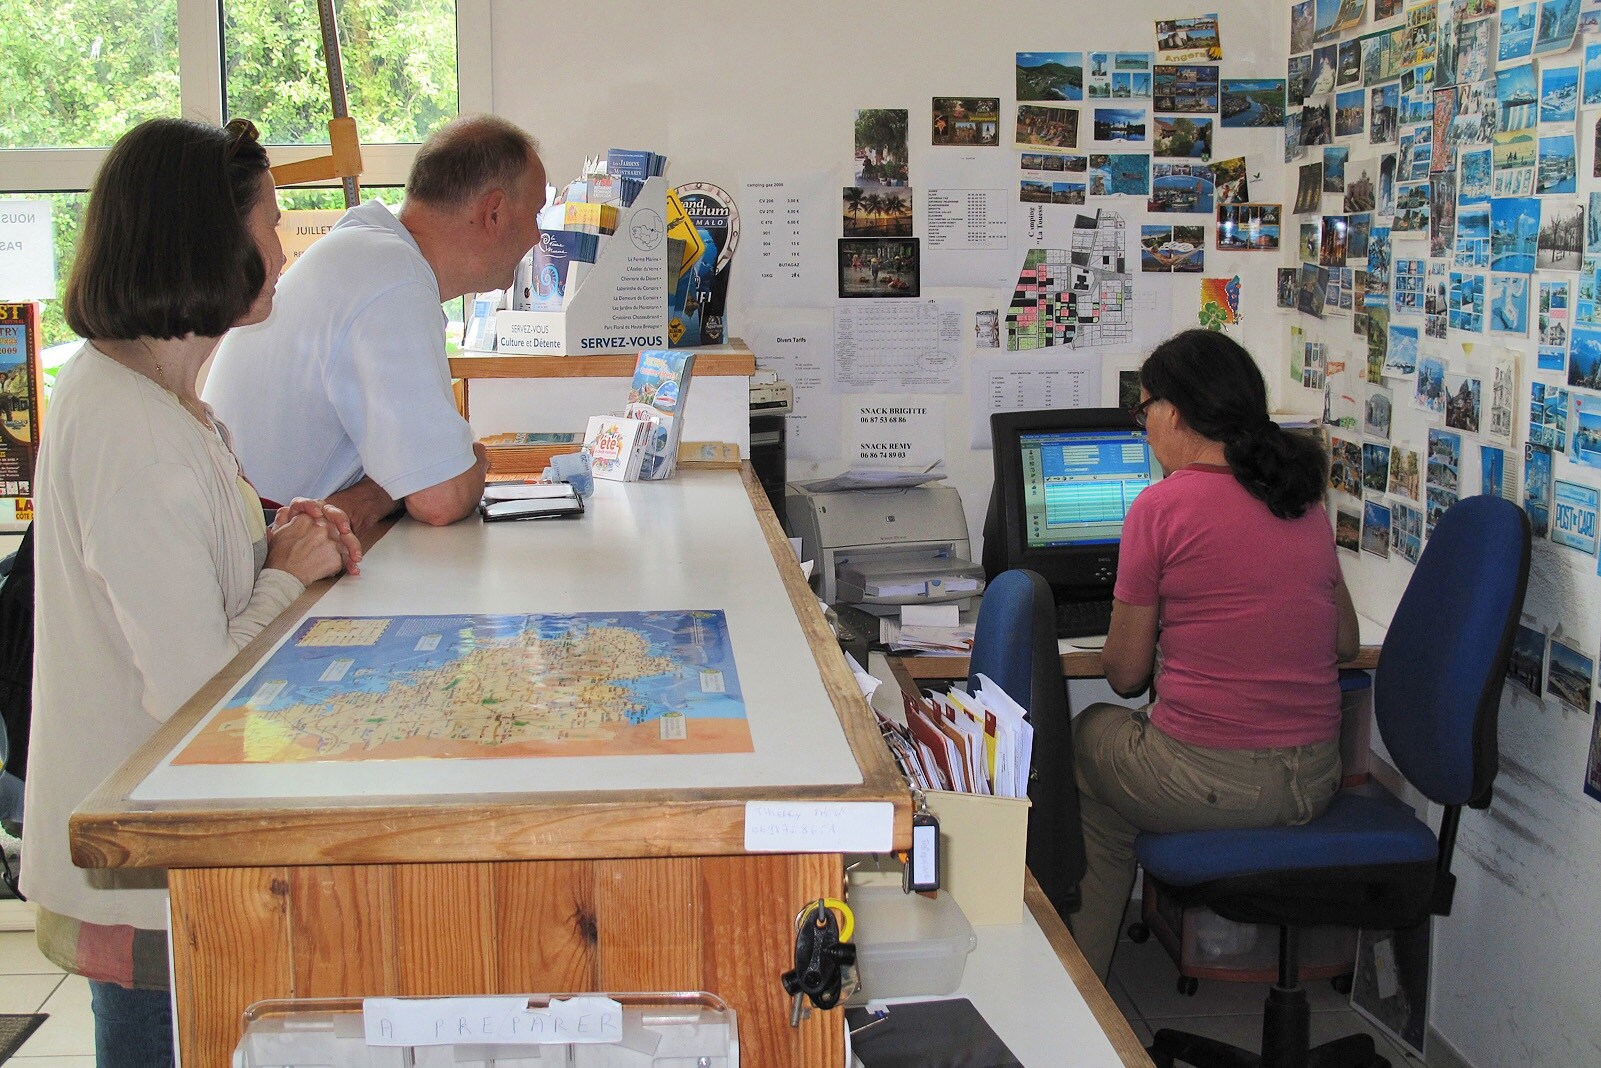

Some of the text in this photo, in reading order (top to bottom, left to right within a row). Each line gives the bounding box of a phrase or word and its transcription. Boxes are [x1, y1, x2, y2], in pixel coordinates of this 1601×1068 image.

[1165, 52, 1206, 62] Angers
[296, 226, 332, 235] JUILLET
[512, 325, 549, 333] SERVEZ-VOUS
[501, 337, 525, 347] Culture
[533, 337, 561, 348] Détente
[581, 336, 662, 349] SERVEZ-VOUS
[1555, 503, 1574, 531] POST
[1578, 509, 1596, 538] CARD
[380, 1018, 393, 1038] A
